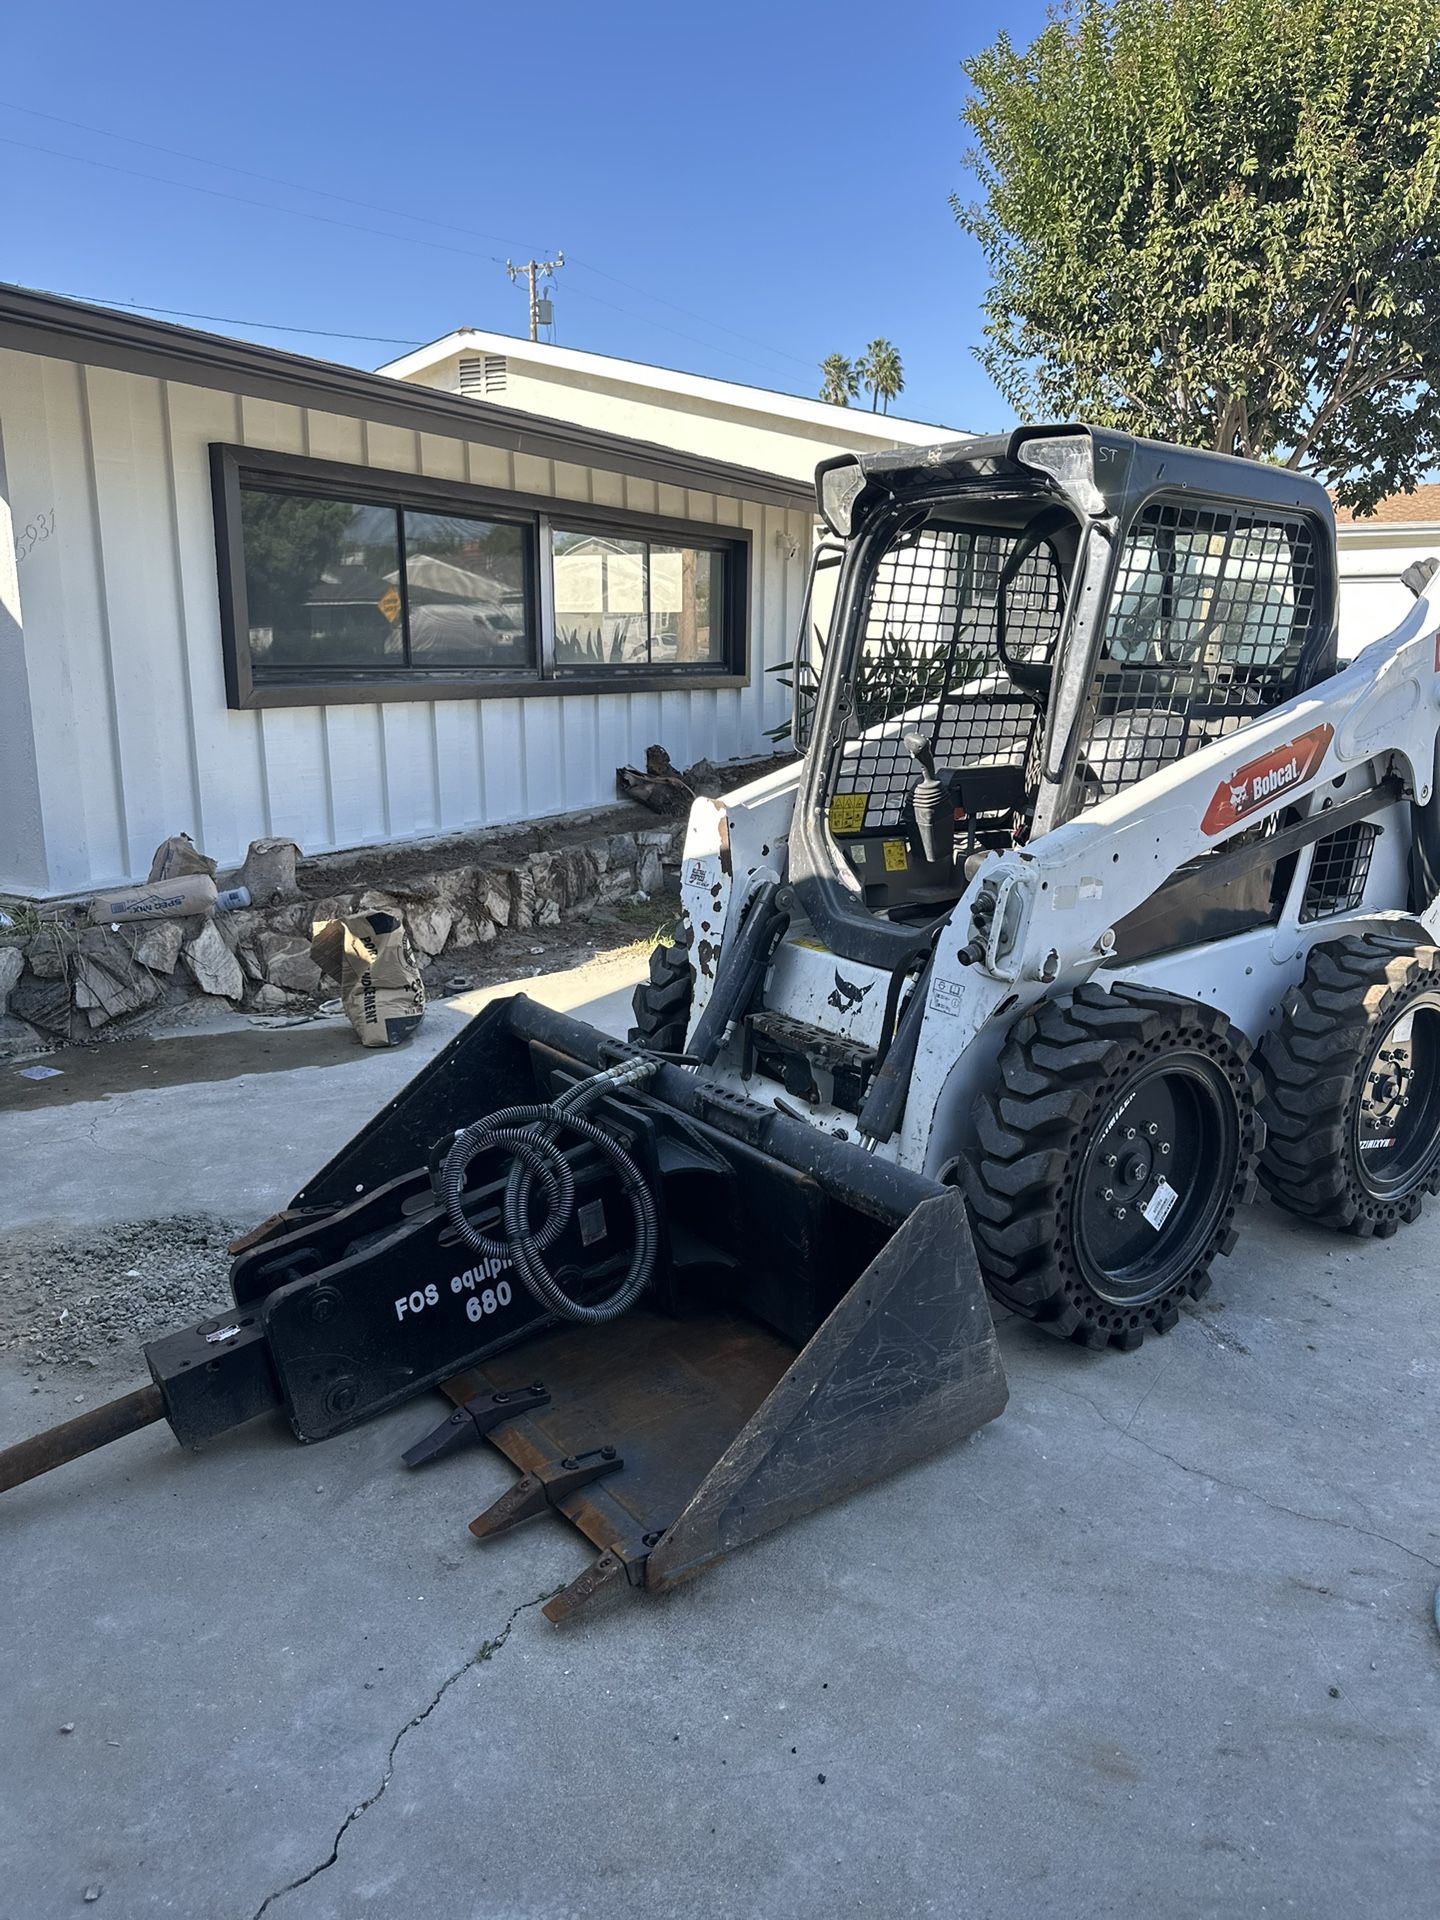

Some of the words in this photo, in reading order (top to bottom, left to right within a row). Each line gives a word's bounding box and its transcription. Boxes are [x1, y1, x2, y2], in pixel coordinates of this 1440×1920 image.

[1098, 446, 1119, 463] ST
[1252, 757, 1298, 801] Bobcat
[394, 1283, 440, 1321] FOS
[465, 1280, 513, 1323] 680
